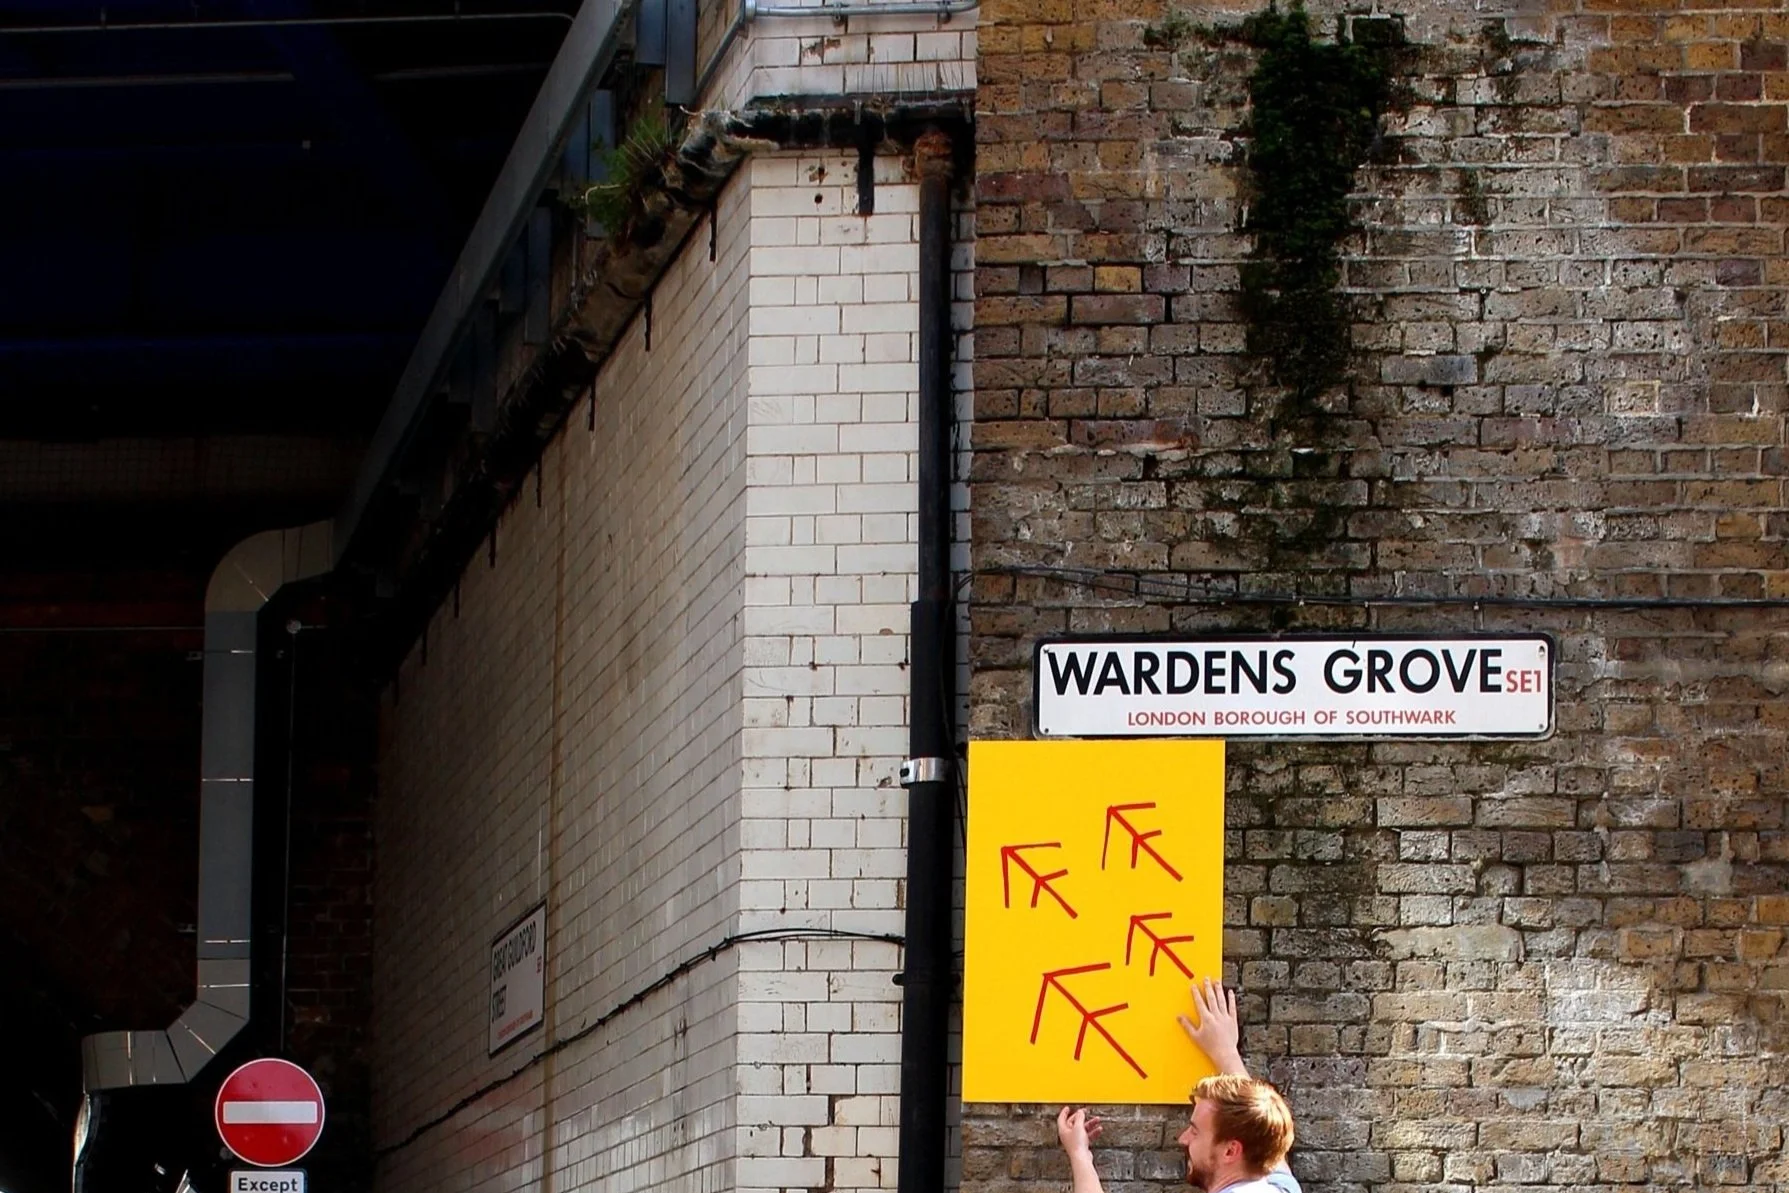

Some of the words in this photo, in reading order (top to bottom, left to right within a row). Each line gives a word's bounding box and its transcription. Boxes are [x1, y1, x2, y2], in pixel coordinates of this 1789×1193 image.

[1048, 649, 1297, 696] WARDENS
[1323, 648, 1502, 694] GROVE
[1506, 670, 1542, 693] SE1
[1127, 711, 1206, 727] LONDON
[1213, 711, 1306, 726] BOROUGH
[1314, 710, 1338, 725] OF
[1346, 710, 1457, 726] SOUTHWARK
[237, 1177, 298, 1193] Except
